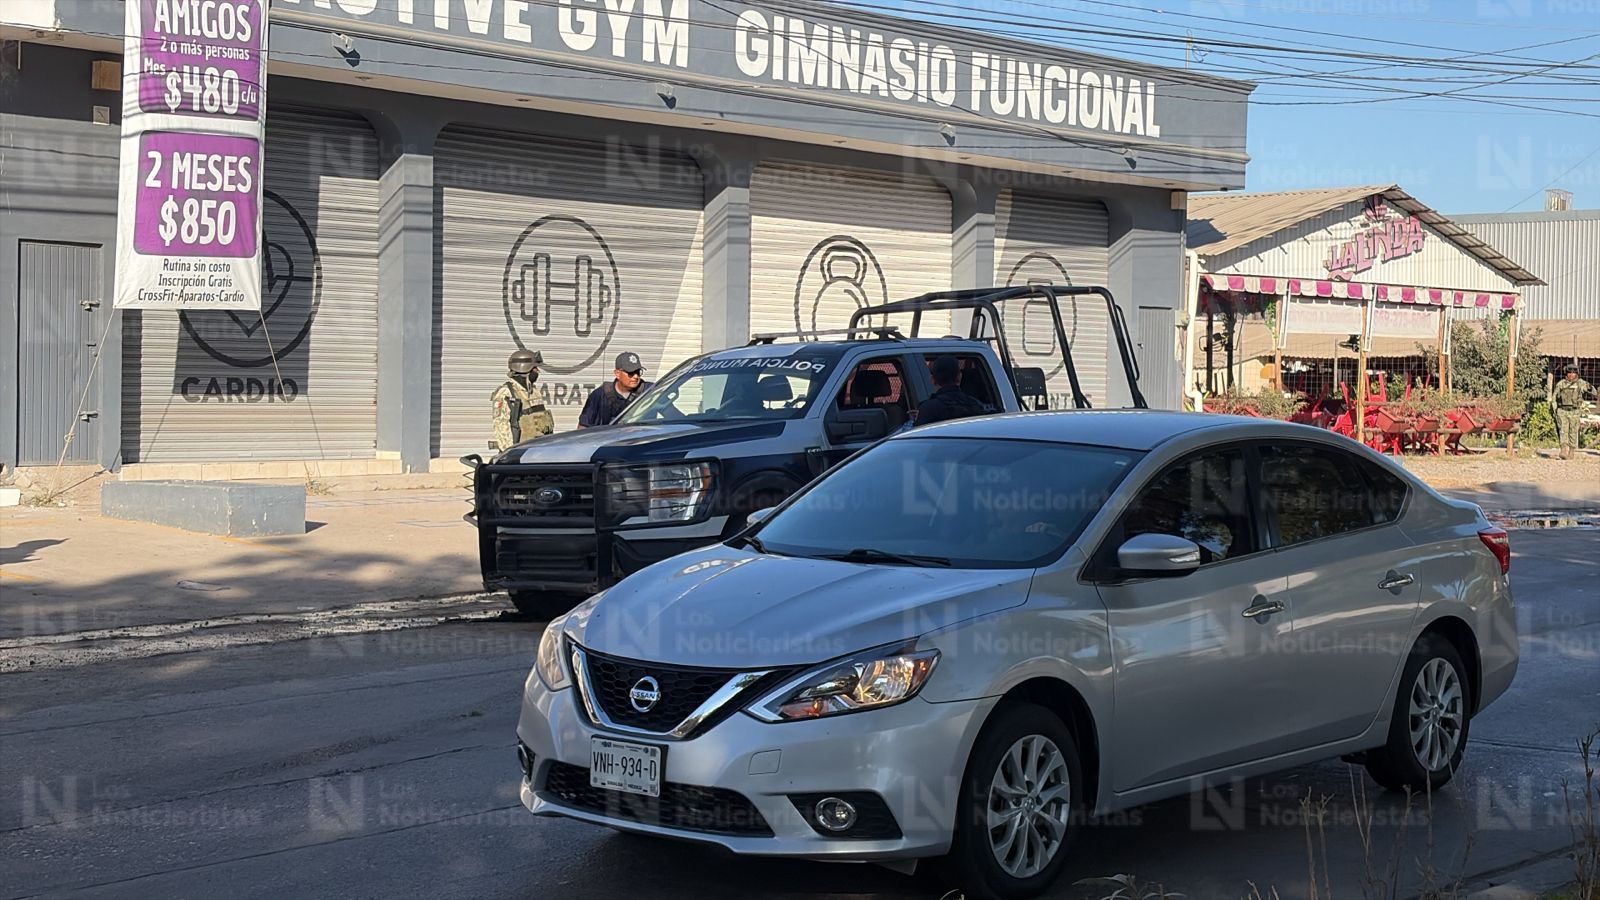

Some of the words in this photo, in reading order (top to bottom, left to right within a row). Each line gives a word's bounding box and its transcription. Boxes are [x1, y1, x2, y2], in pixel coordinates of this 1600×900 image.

[154, 0, 252, 41] AMIGOS
[558, 0, 690, 68] GYM
[160, 36, 168, 51] 2
[170, 42, 177, 53] o
[180, 40, 203, 55] más
[205, 45, 250, 60] personas
[144, 58, 166, 75] Mes
[735, 10, 956, 107] GIMNASIO
[970, 51, 1160, 138] FUNCIONAL
[165, 66, 240, 115] $480
[241, 85, 258, 104] c/u
[145, 151, 162, 188] 2
[171, 152, 252, 193] MESES
[159, 195, 237, 246] $850
[163, 259, 191, 272] Rutina
[194, 259, 206, 272] sin
[209, 262, 231, 273] costo
[1328, 242, 1357, 272] LA
[138, 288, 245, 304] CrossFit-Aparatos-Cardio
[158, 275, 206, 291] Inscripción
[208, 275, 233, 287] Gratis
[181, 376, 299, 404] CARDIO
[538, 382, 597, 406] ARAT
[631, 690, 657, 699] NISSAN
[593, 751, 657, 781] VNH-934-D
